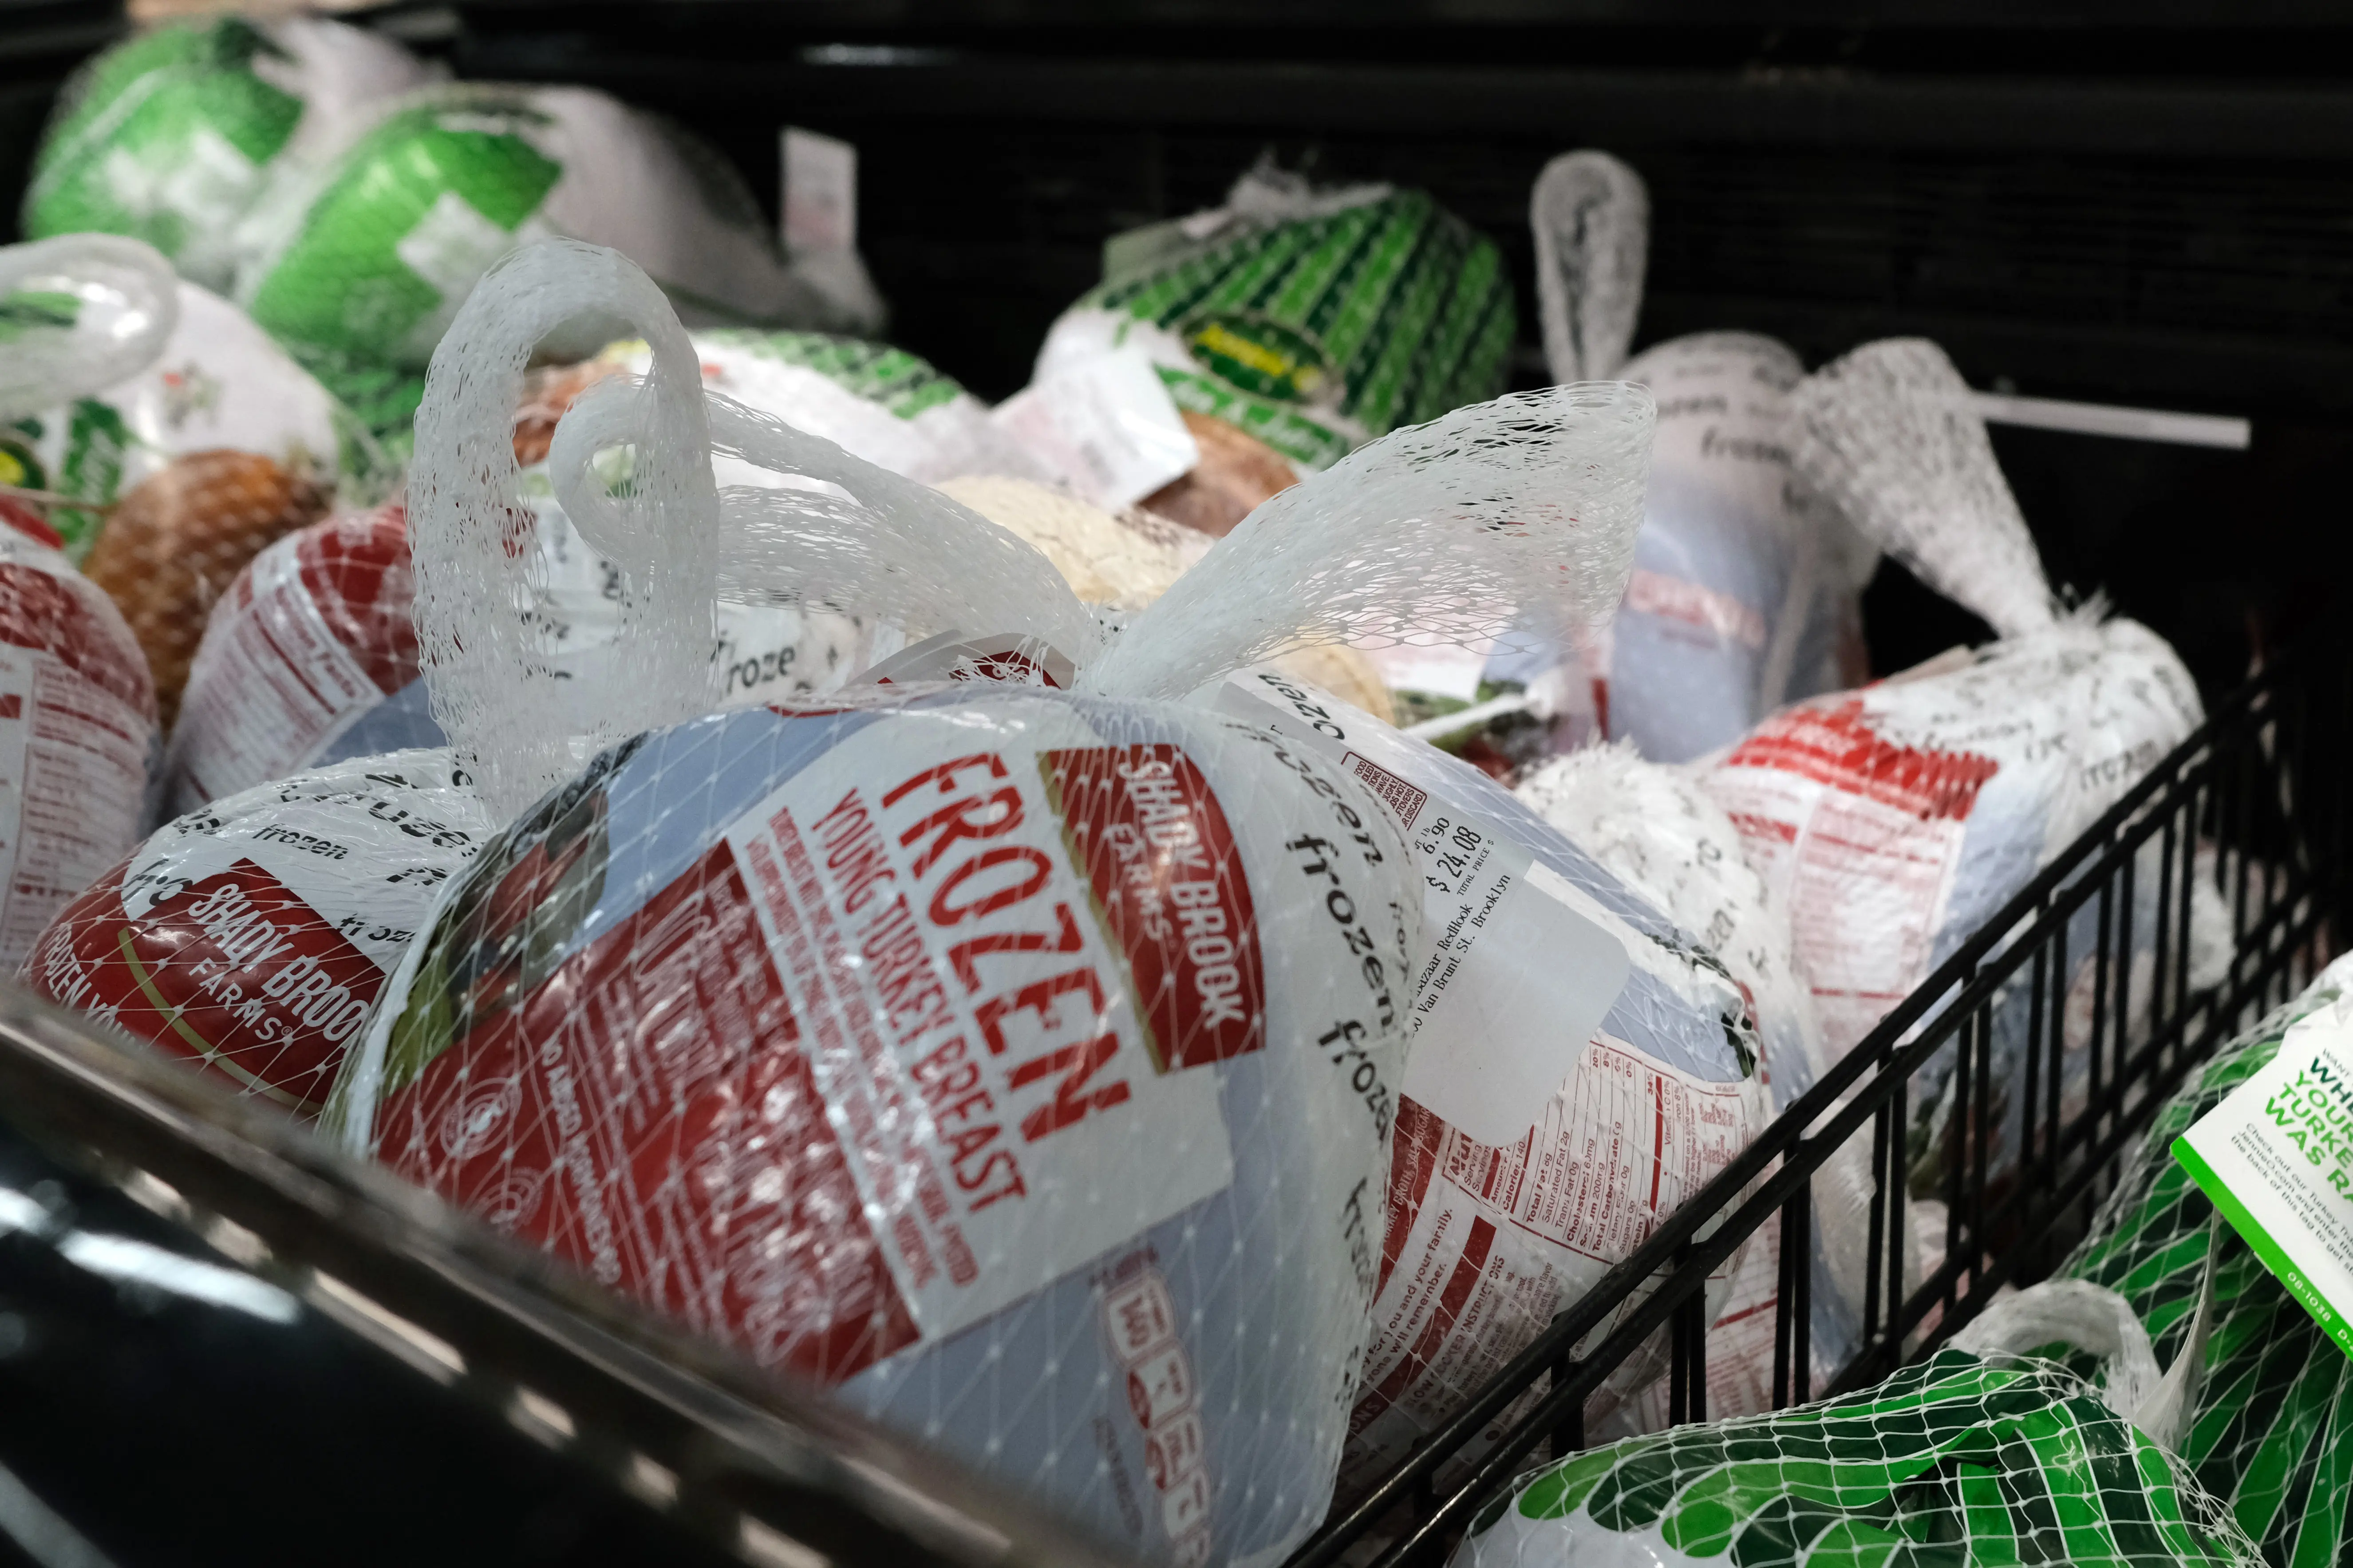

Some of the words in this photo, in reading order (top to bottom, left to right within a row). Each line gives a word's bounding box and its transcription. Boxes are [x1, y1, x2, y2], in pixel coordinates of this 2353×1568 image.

[253, 823, 349, 860] frozen
[1422, 817, 1450, 854] 6.90
[1437, 826, 1482, 878] 24.08
[1425, 875, 1451, 893] $
[1457, 874, 1475, 896] TOTAL
[1472, 847, 1490, 871] PRICE
[1118, 761, 1211, 869] SHADY
[1170, 879, 1246, 1030] BROOK
[882, 752, 1130, 1143] FROZEN
[1285, 833, 1394, 1029] frozen
[1417, 993, 1439, 1013] Van
[1433, 956, 1461, 991] Brunt
[1456, 935, 1476, 953] St.
[1471, 874, 1511, 928] Brooklyn
[1437, 903, 1473, 950] RedHook
[187, 883, 295, 974] SHADY
[261, 953, 372, 1044] BROO
[811, 788, 896, 915] YOUNG
[857, 892, 955, 1045] TURKEY
[911, 1034, 1026, 1213] BREAST
[1603, 1052, 1610, 1068] 8%
[1626, 1061, 1632, 1078] 0%
[1515, 1141, 1526, 1160] 140
[1559, 1131, 1570, 1146] 2g
[2265, 1096, 2326, 1166] WAS
[1465, 1144, 1482, 1186] Serving
[1556, 1147, 1566, 1167] Fat
[1569, 1161, 1579, 1176] 0g
[1619, 1165, 1630, 1179] 0g
[2246, 1123, 2274, 1155] Check
[2274, 1155, 2292, 1173] out
[2291, 1174, 2308, 1191] our
[2310, 1191, 2338, 1225] Turkey
[1526, 1193, 1542, 1223] Total
[1542, 1168, 1563, 1223] Saturated
[1564, 1177, 1575, 1198] Fat
[2231, 1135, 2246, 1153] the
[2246, 1154, 2270, 1180] back
[2270, 1179, 2282, 1190] of
[2282, 1191, 2298, 1212] this
[2299, 1210, 2315, 1230] tag
[2316, 1229, 2326, 1243] to
[1555, 1199, 1570, 1228] Trans
[2295, 1194, 2315, 1213] and
[2314, 1213, 2339, 1240] enter
[1592, 1222, 1606, 1252] Total
[1619, 1216, 1633, 1254] Sugars
[1399, 1284, 1417, 1310] and
[1414, 1253, 1433, 1284] your
